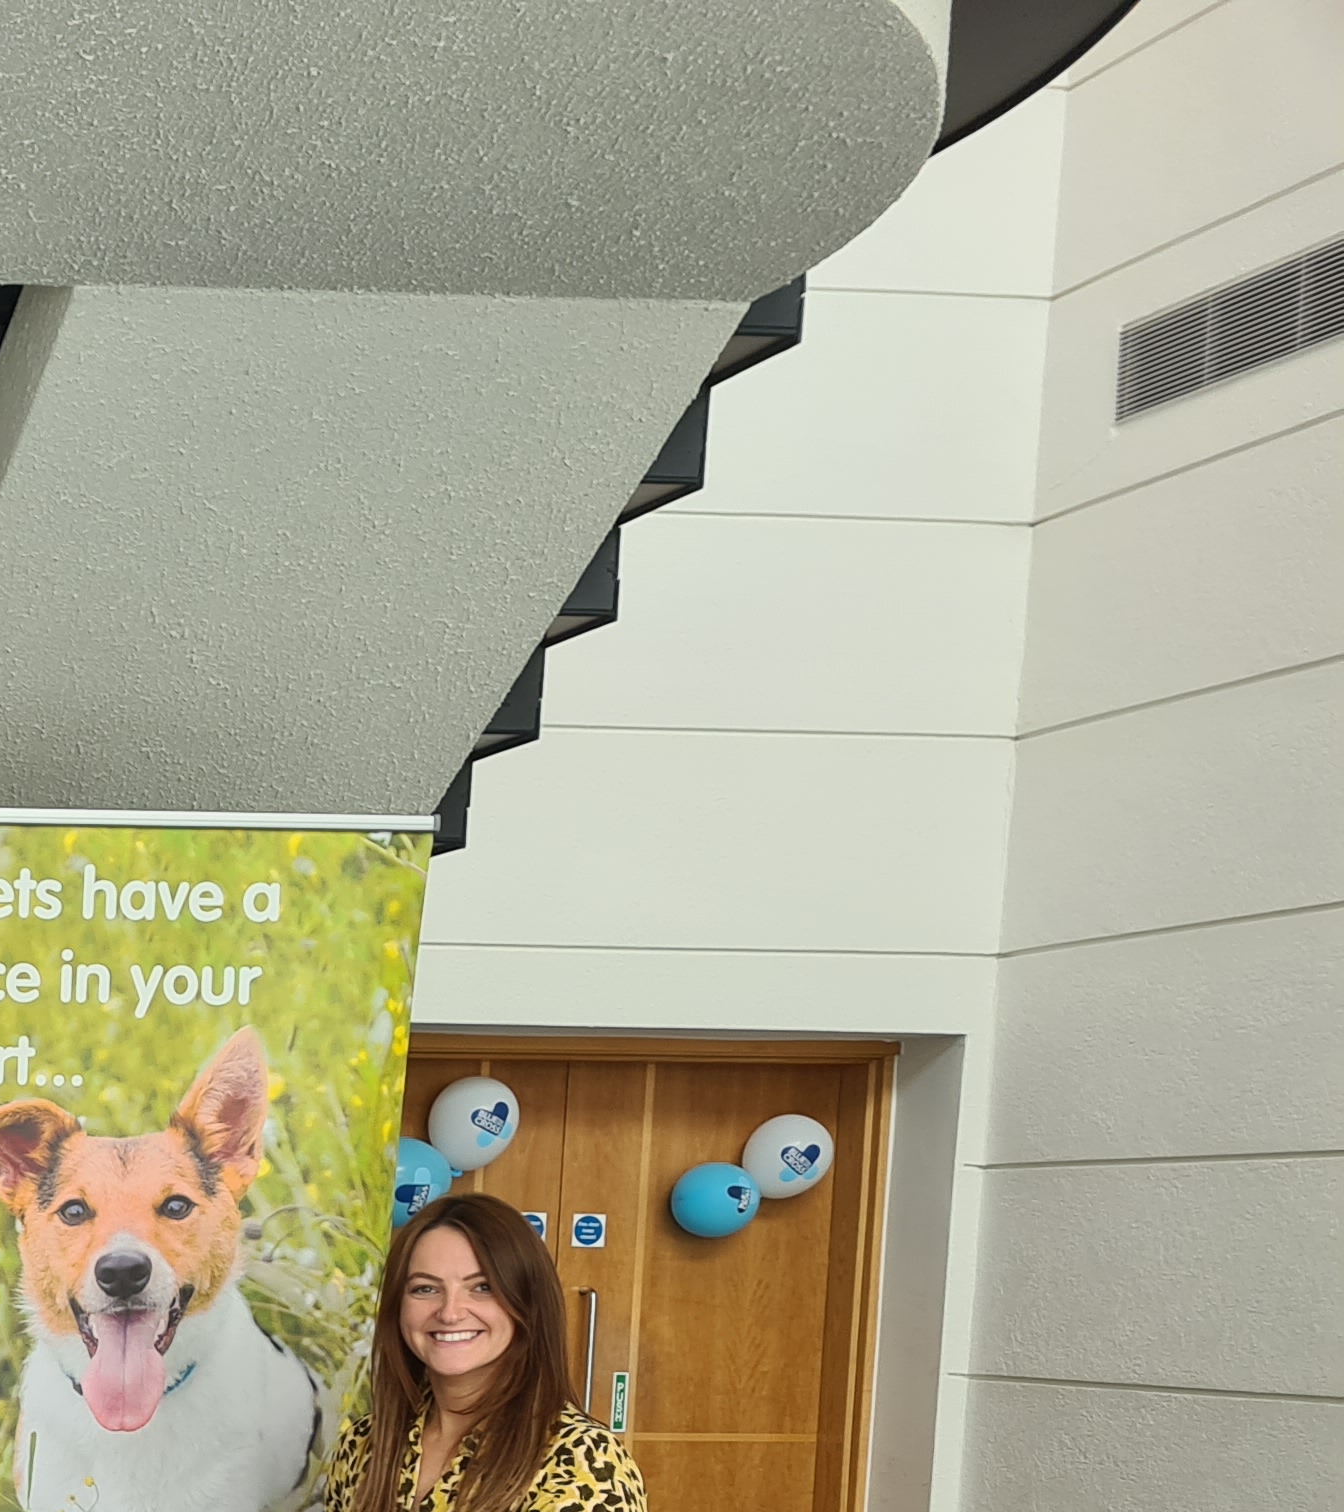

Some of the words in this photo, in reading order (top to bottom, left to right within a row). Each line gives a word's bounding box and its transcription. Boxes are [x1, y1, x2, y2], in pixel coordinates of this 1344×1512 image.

[81, 863, 225, 922] have
[242, 881, 282, 923] a
[59, 948, 111, 1004] in
[130, 963, 263, 1019] your
[615, 1382, 625, 1423] PUSH
